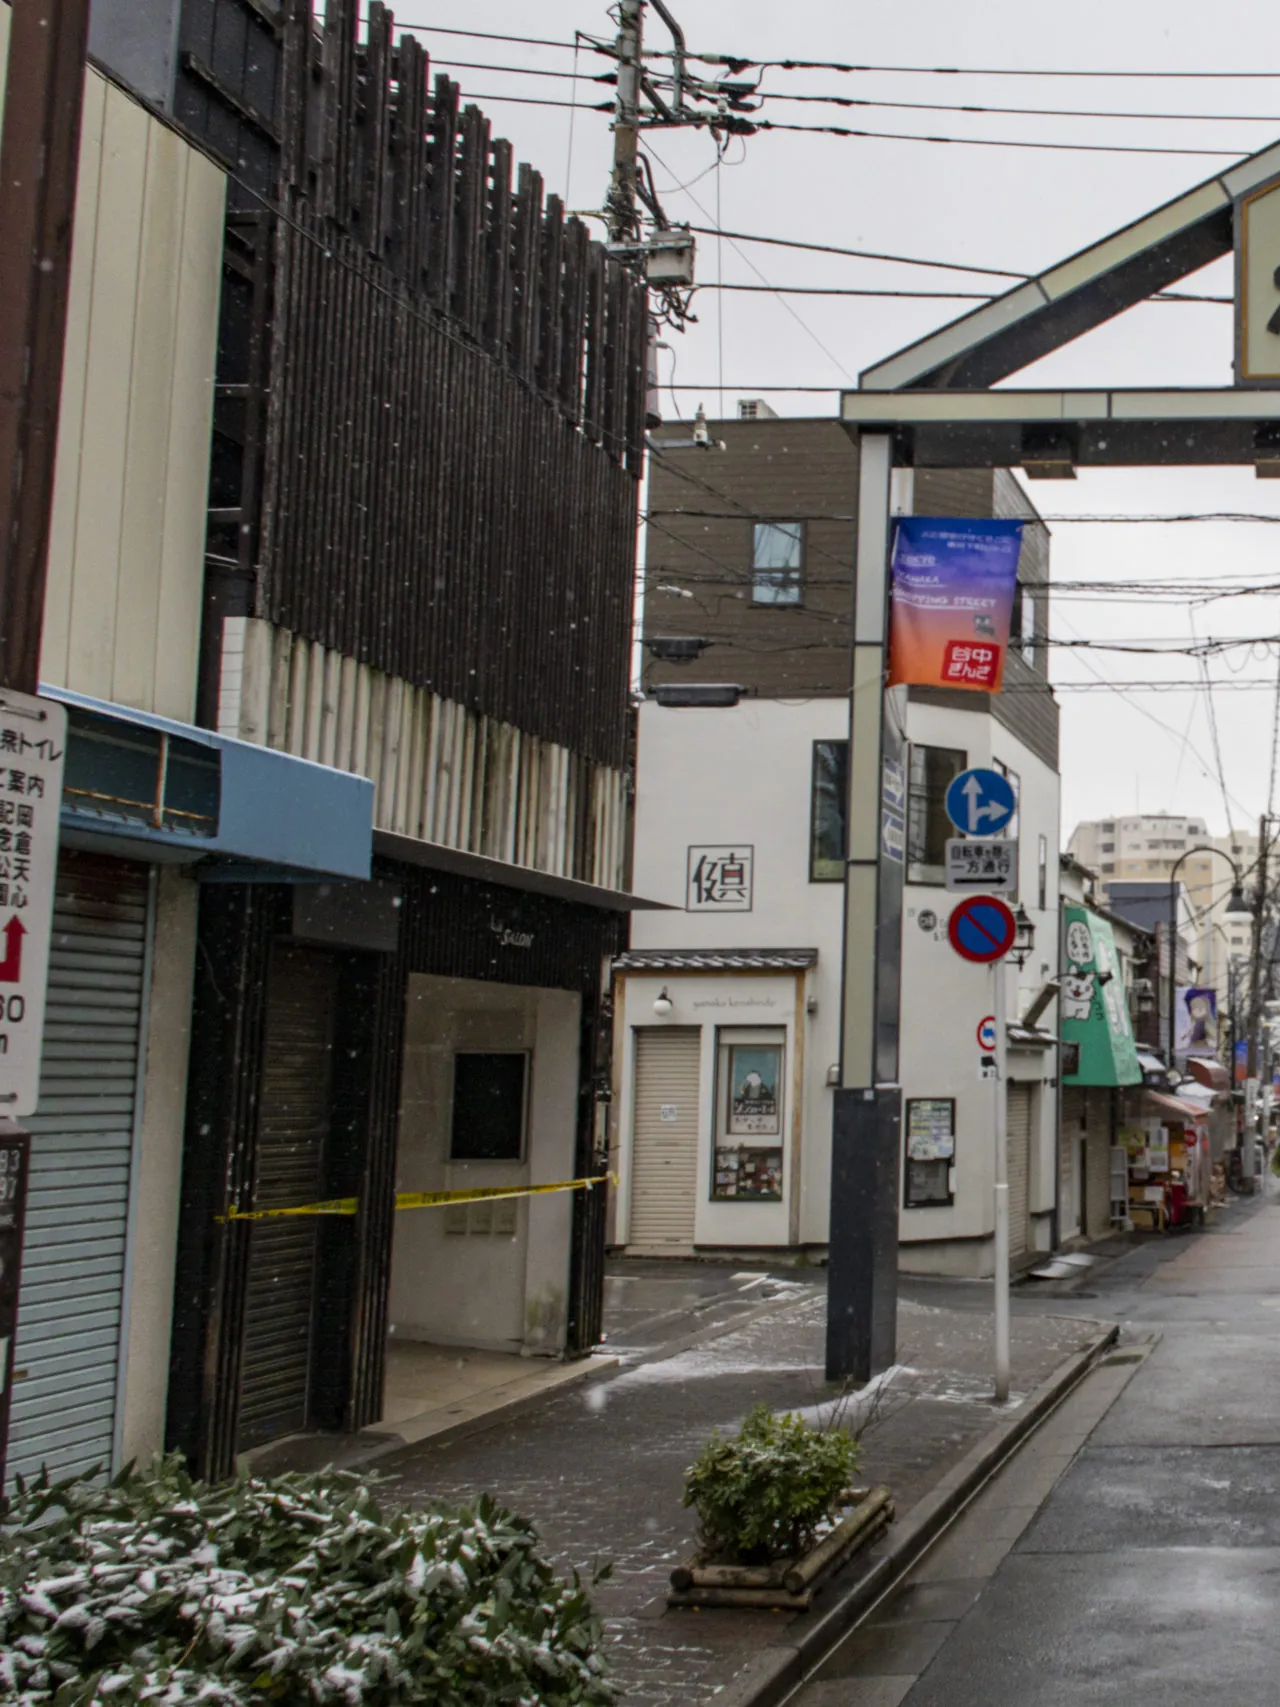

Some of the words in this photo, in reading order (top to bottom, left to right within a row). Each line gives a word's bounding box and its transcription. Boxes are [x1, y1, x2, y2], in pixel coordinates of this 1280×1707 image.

[11, 803, 34, 908] 岡倉天心
[950, 860, 1010, 874] 一方通行
